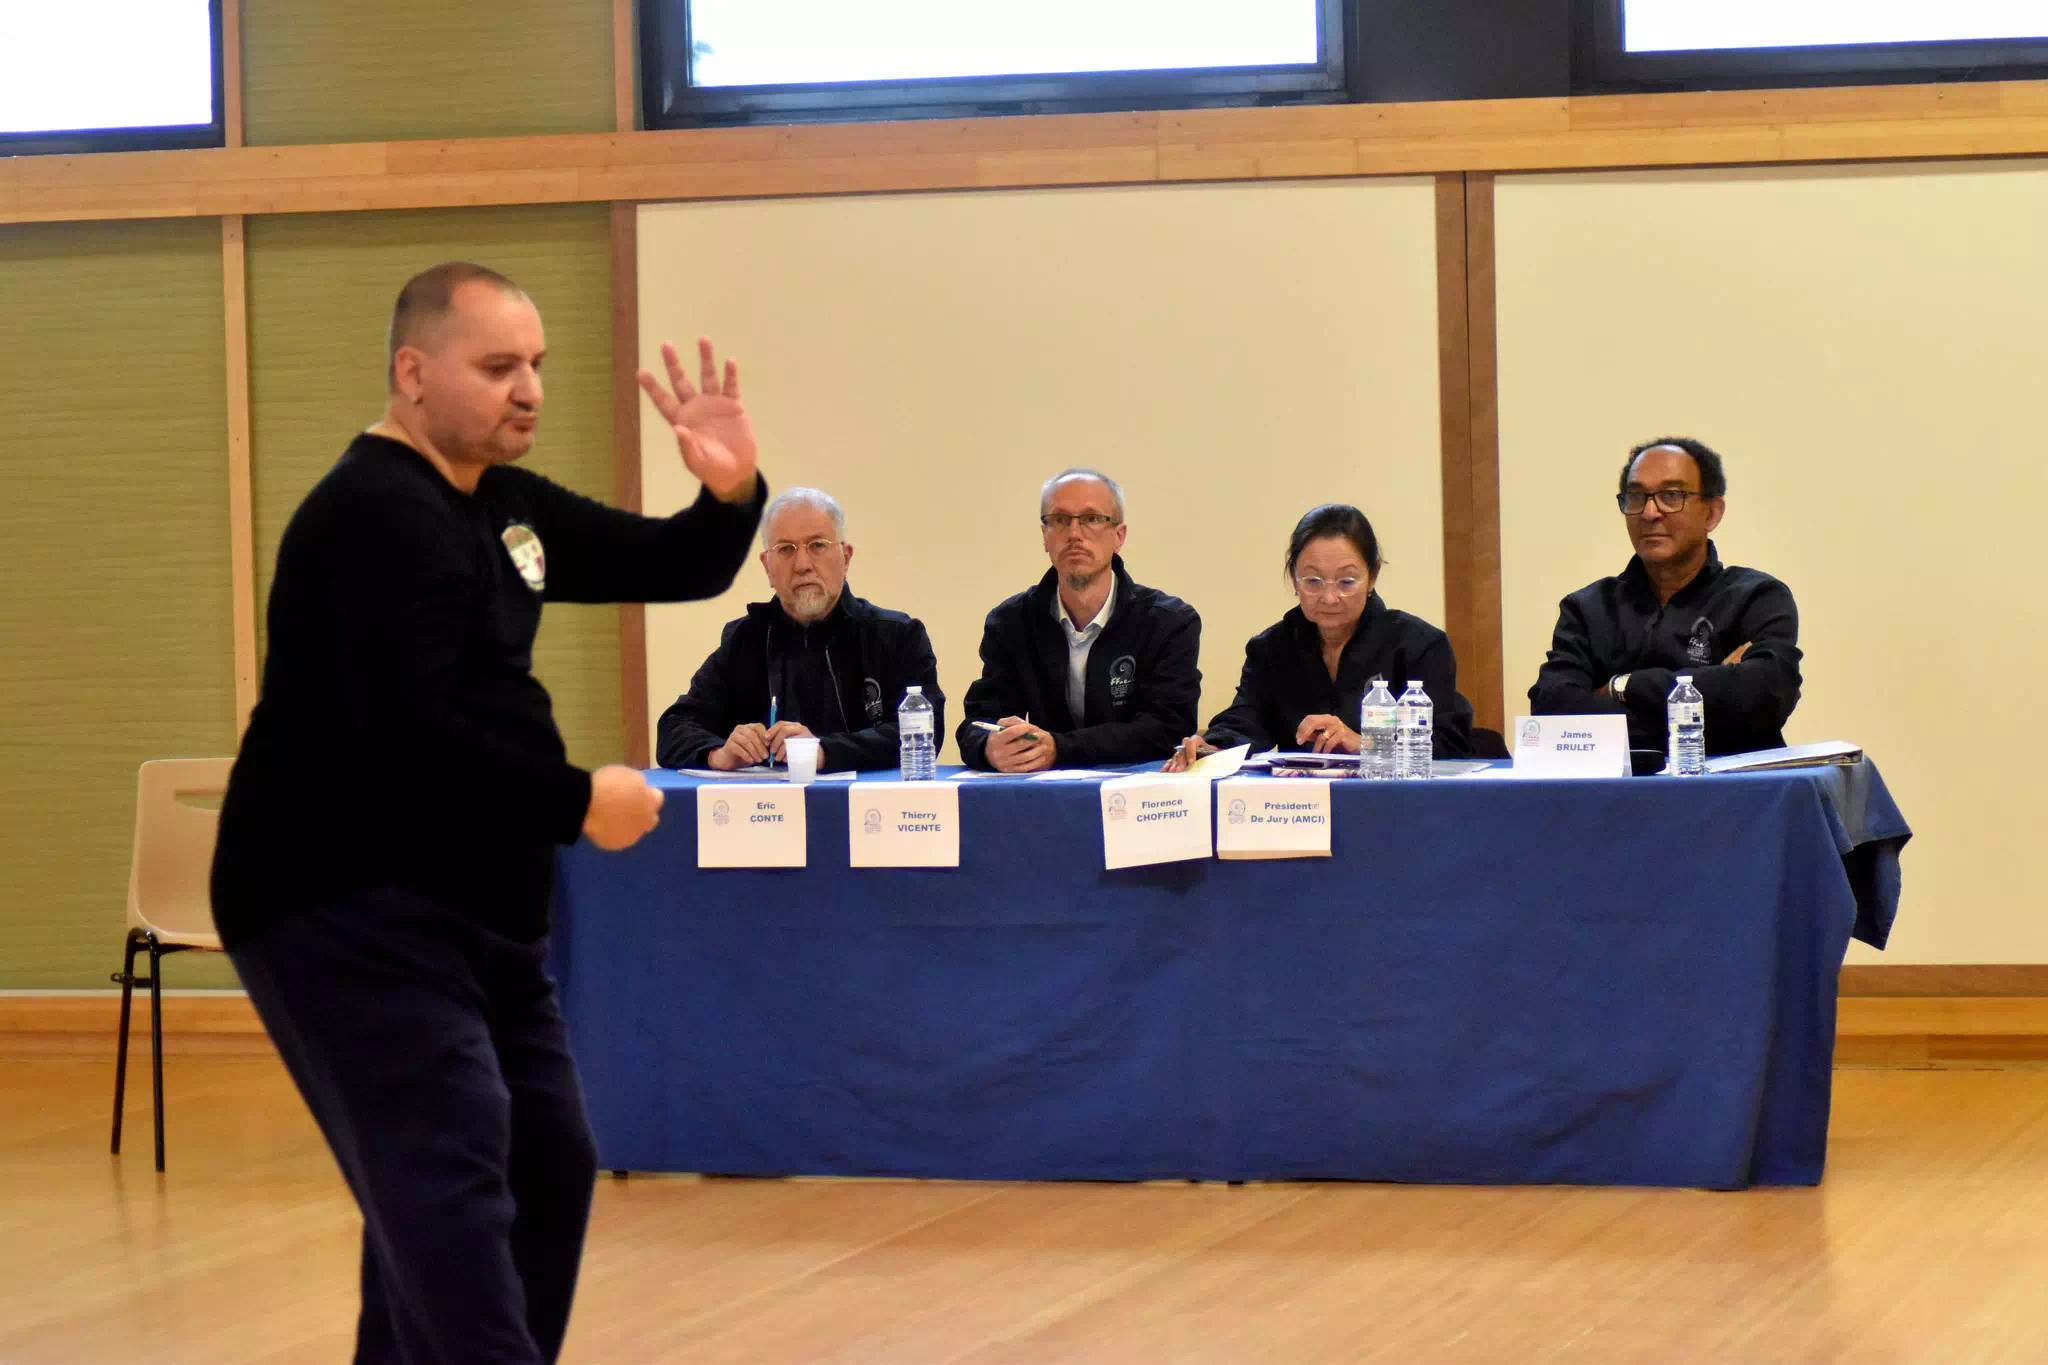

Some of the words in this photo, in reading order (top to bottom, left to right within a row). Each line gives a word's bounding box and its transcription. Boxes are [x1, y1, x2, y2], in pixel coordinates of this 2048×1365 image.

[1560, 730, 1593, 739] James
[1556, 743, 1596, 752] BRULET
[756, 801, 776, 810] Eric
[1141, 799, 1183, 809] Florence
[750, 814, 784, 823] CONTE
[901, 811, 937, 821] Thierry
[1136, 809, 1189, 823] CHOFFRUT
[1250, 814, 1265, 823] De
[1266, 814, 1290, 825] Jury
[1291, 814, 1327, 825] (AMCI)
[897, 823, 941, 833] VICENTE
